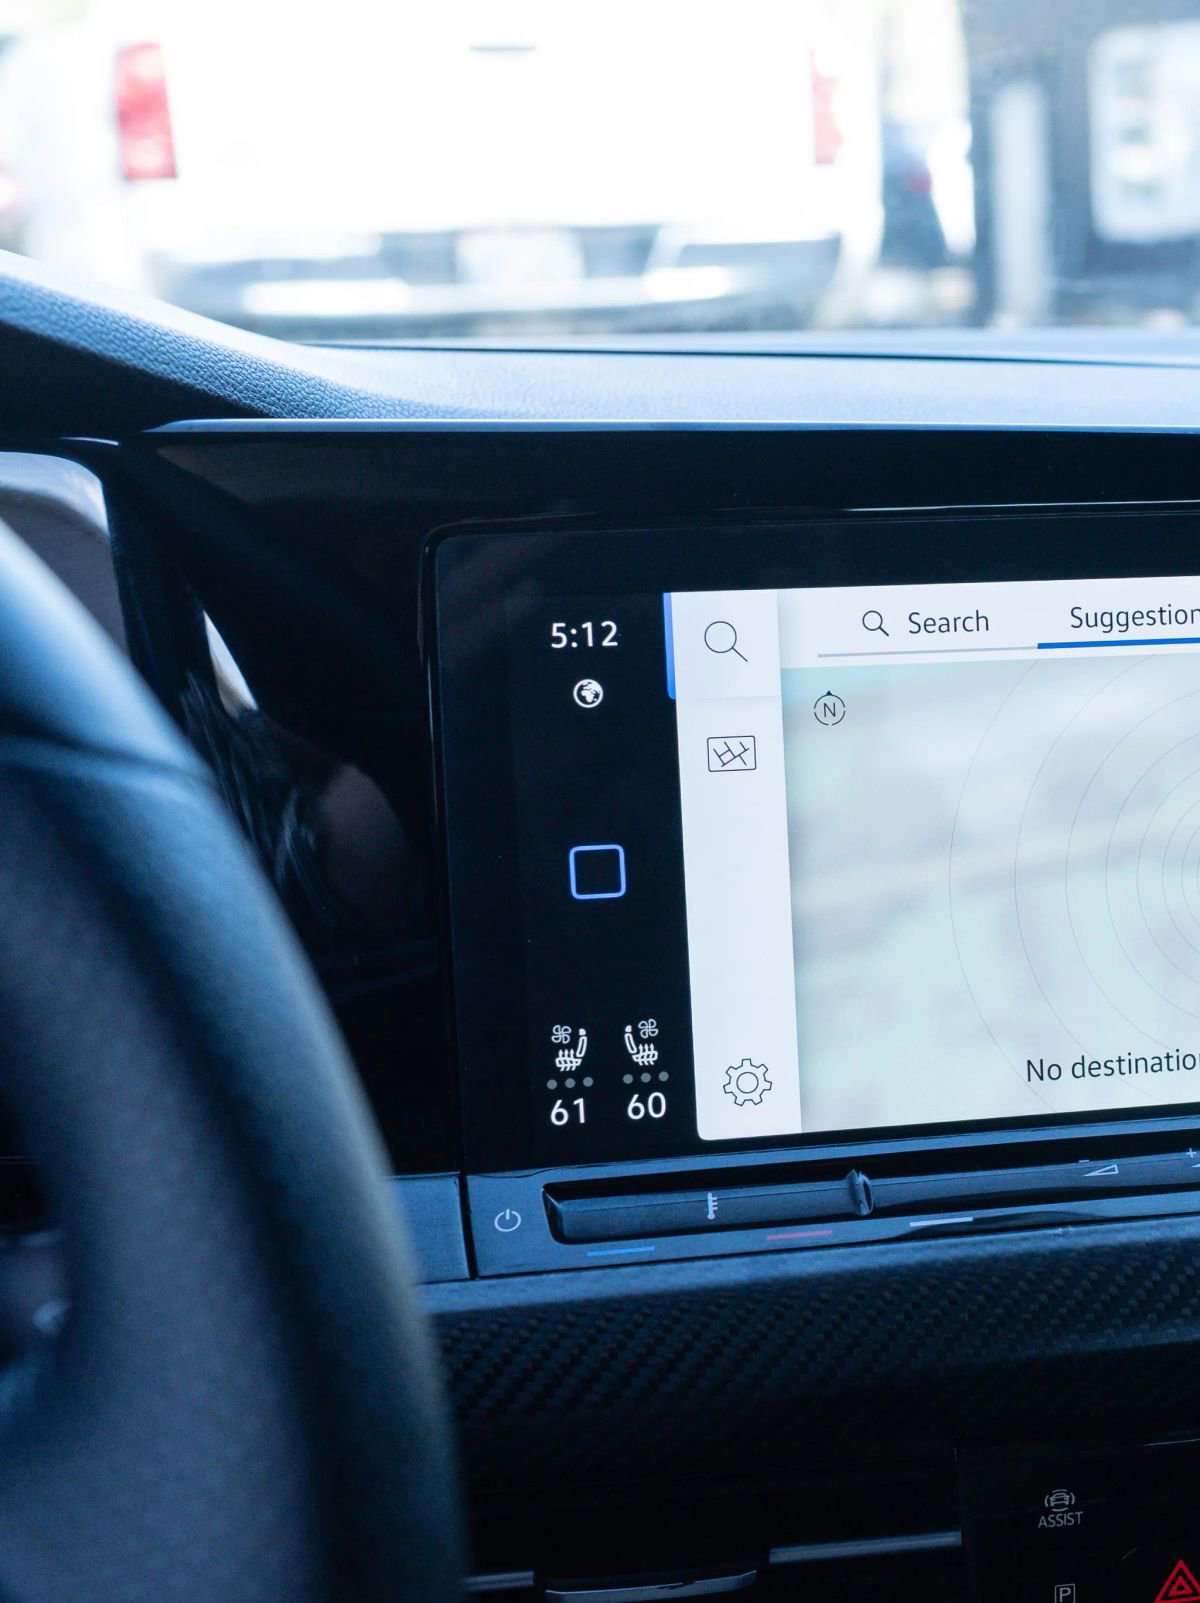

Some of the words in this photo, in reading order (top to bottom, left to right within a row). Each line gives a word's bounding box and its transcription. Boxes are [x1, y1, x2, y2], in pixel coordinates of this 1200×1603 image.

[909, 610, 988, 634] Search
[552, 621, 618, 648] 5:12
[824, 703, 836, 717] N
[1027, 1059, 1061, 1082] No
[551, 1098, 585, 1125] 61
[628, 1092, 666, 1119] 60
[1038, 1512, 1083, 1528] ASSIST
[1059, 1587, 1071, 1603] P
